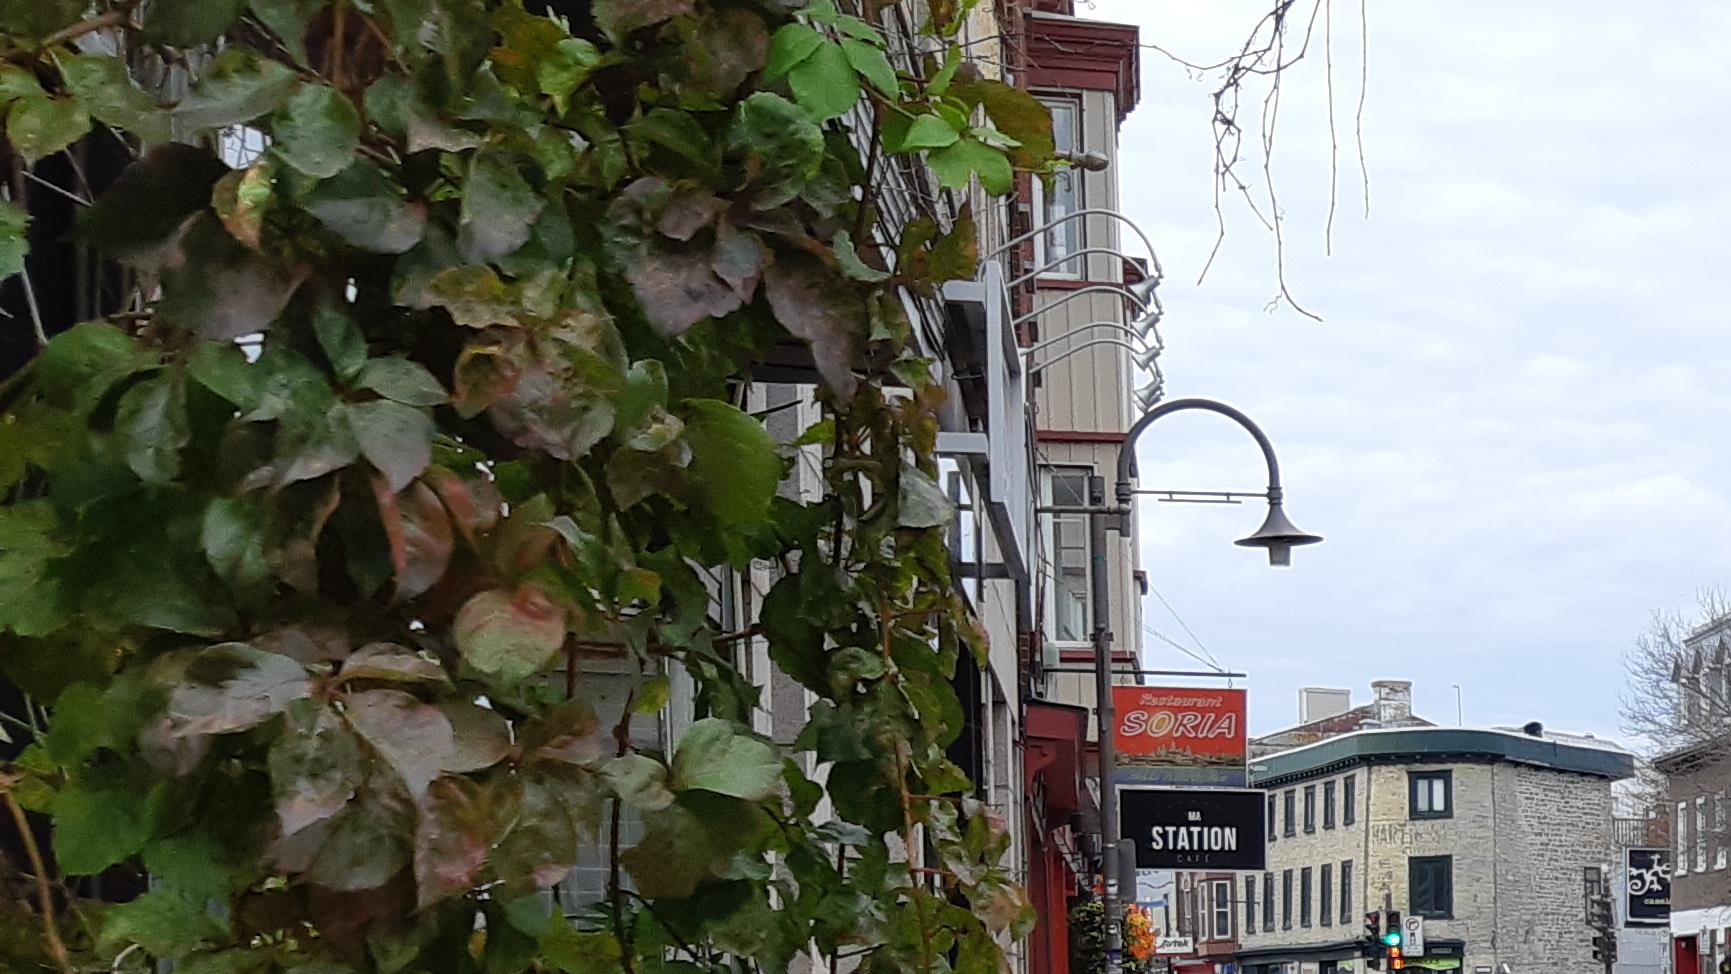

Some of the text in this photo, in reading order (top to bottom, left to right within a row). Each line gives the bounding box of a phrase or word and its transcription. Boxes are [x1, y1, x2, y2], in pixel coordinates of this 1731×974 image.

[1139, 692, 1223, 707] Restaurant
[1120, 710, 1236, 738] SORIA
[1187, 811, 1202, 822] MA
[1151, 826, 1237, 851] STATION
